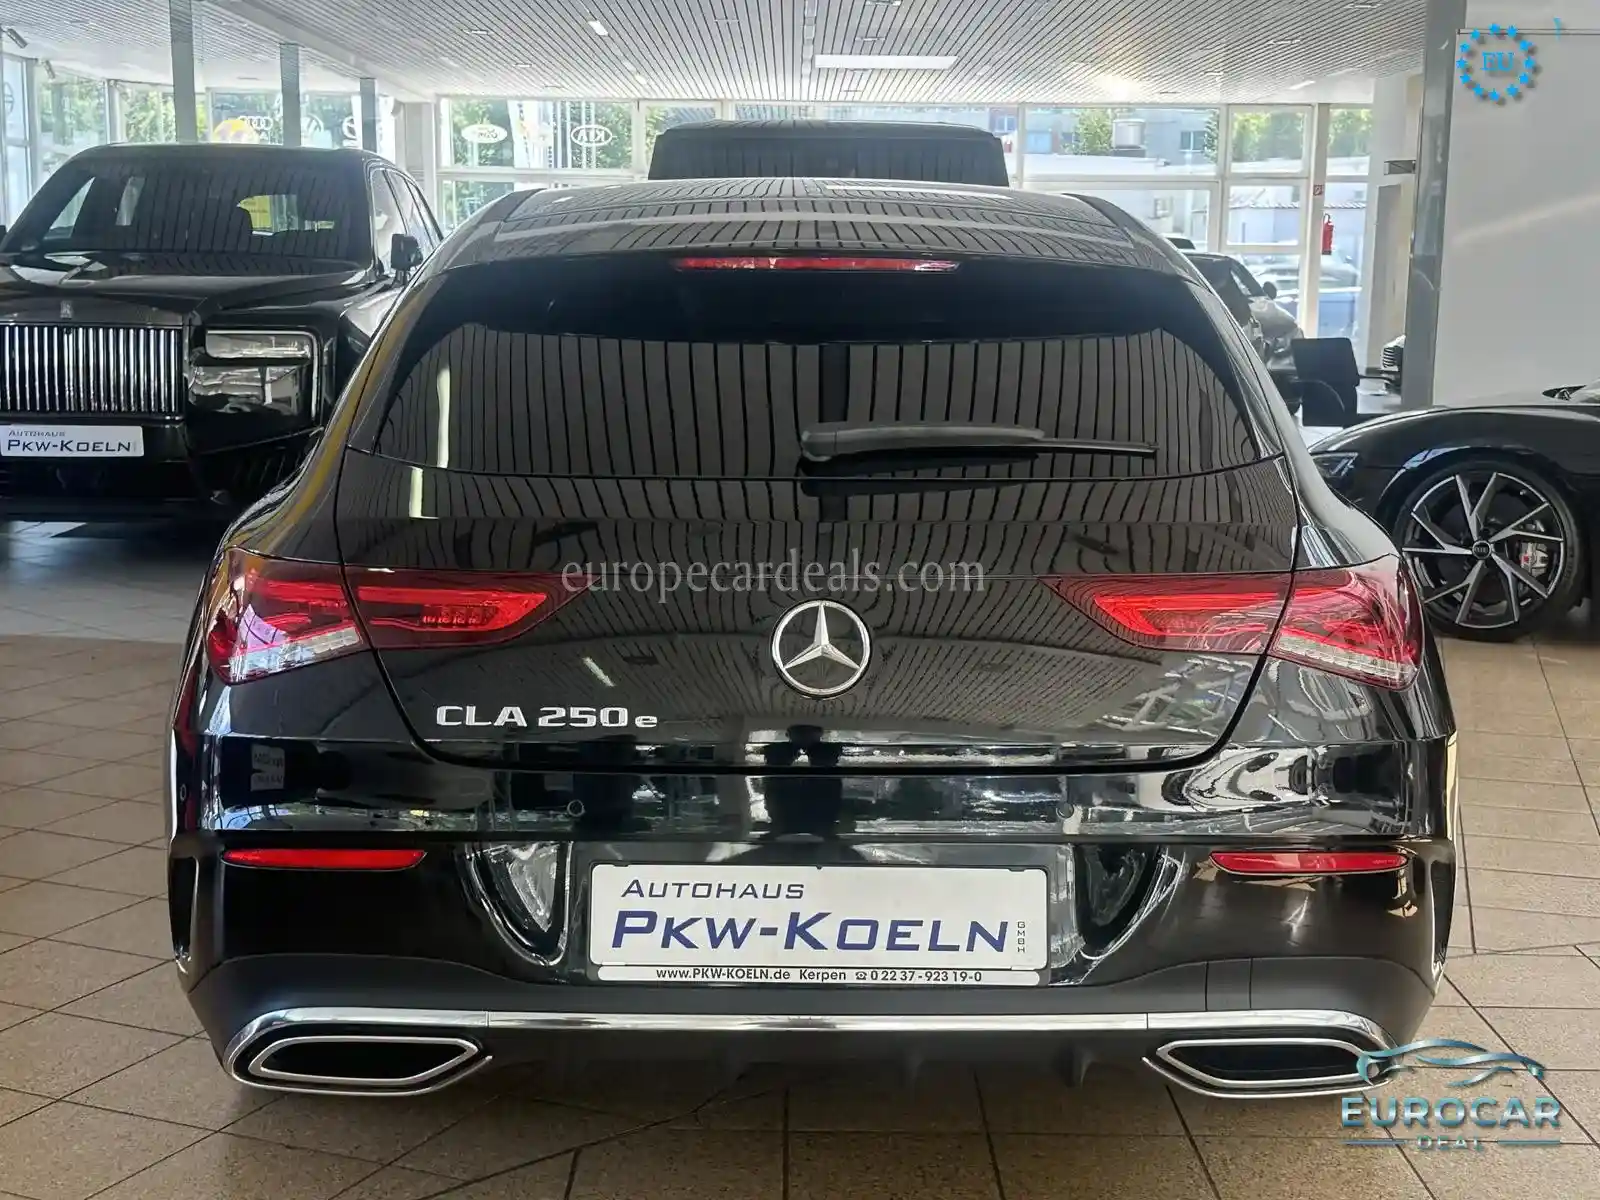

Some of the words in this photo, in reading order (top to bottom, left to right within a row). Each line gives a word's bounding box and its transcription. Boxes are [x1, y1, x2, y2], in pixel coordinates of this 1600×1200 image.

[436, 705, 528, 727] CLA
[621, 879, 805, 899] AUTOHAUS
[612, 910, 1009, 953] PKW-KOELN
[656, 967, 791, 981] www.PKW-KOELN.de
[800, 969, 847, 982] Kerpen
